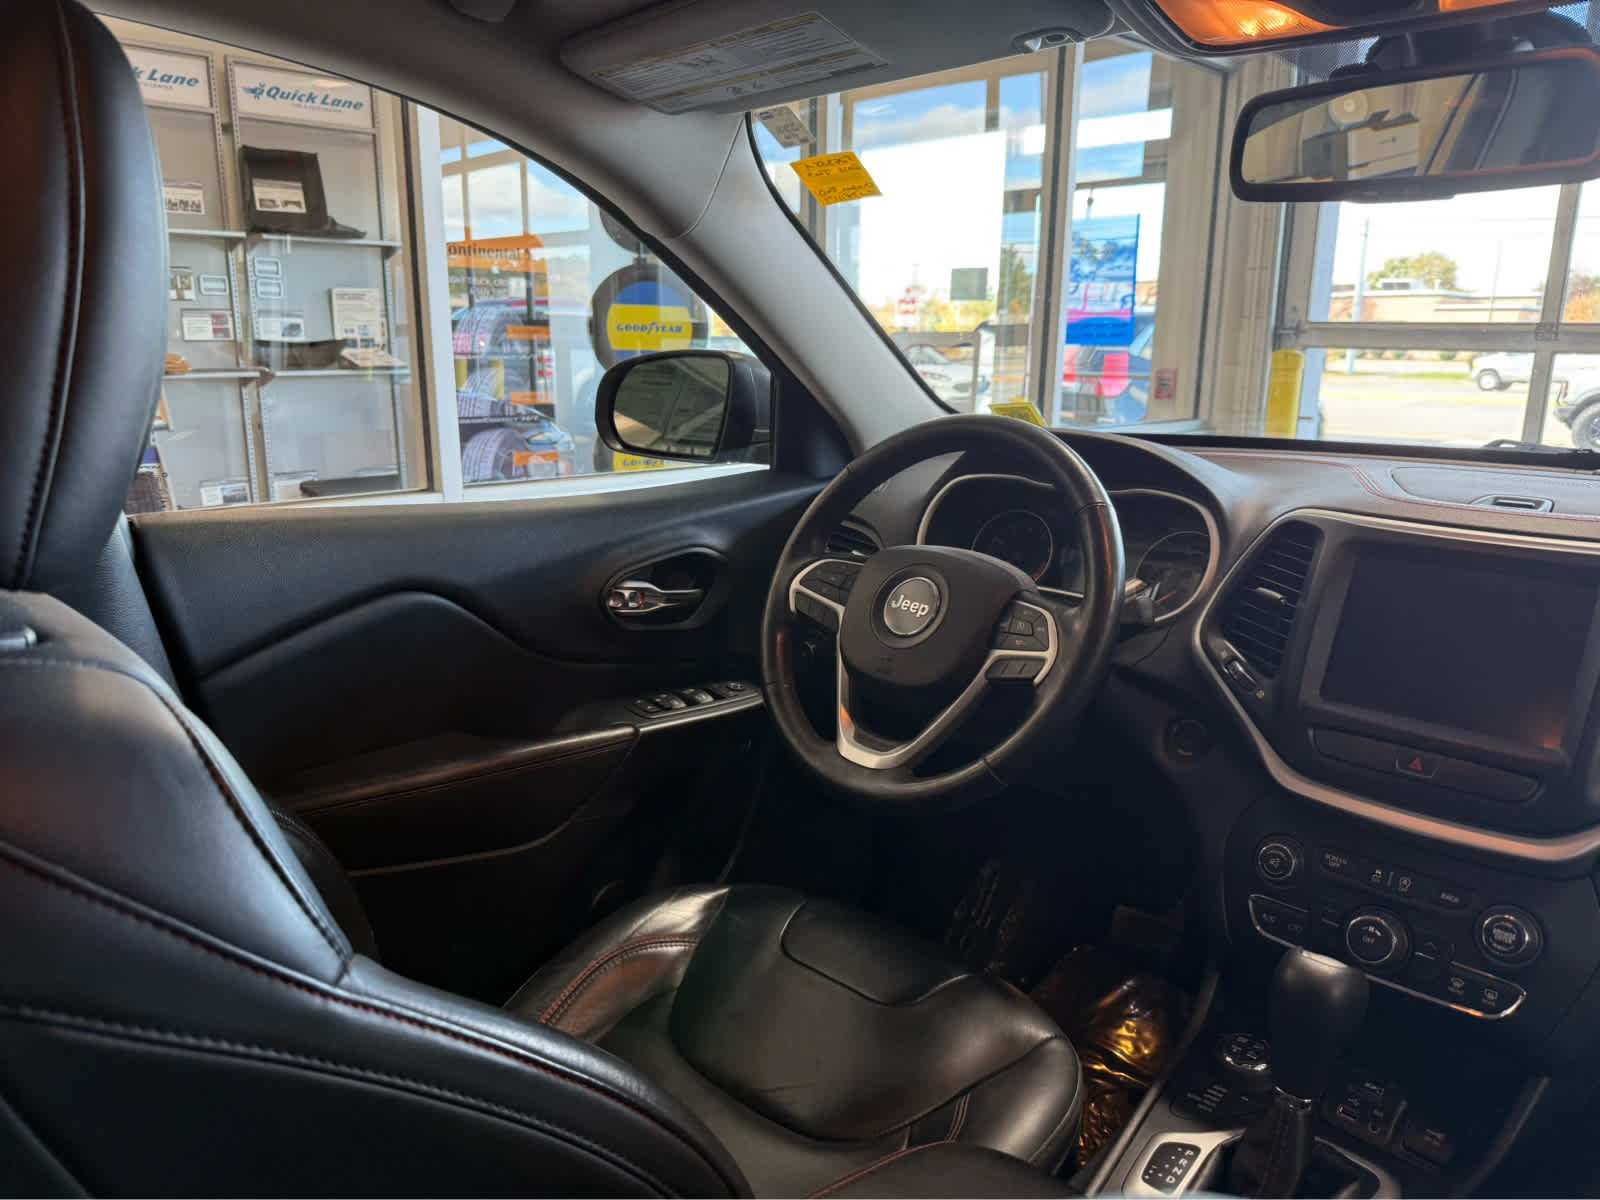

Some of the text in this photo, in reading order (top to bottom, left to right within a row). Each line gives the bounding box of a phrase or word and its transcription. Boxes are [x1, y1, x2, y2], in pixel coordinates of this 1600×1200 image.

[147, 68, 200, 87] Lane
[266, 86, 318, 104] Quick
[321, 94, 365, 111] Lane
[891, 594, 929, 618] Jeep
[1166, 1149, 1195, 1184] P R N D
